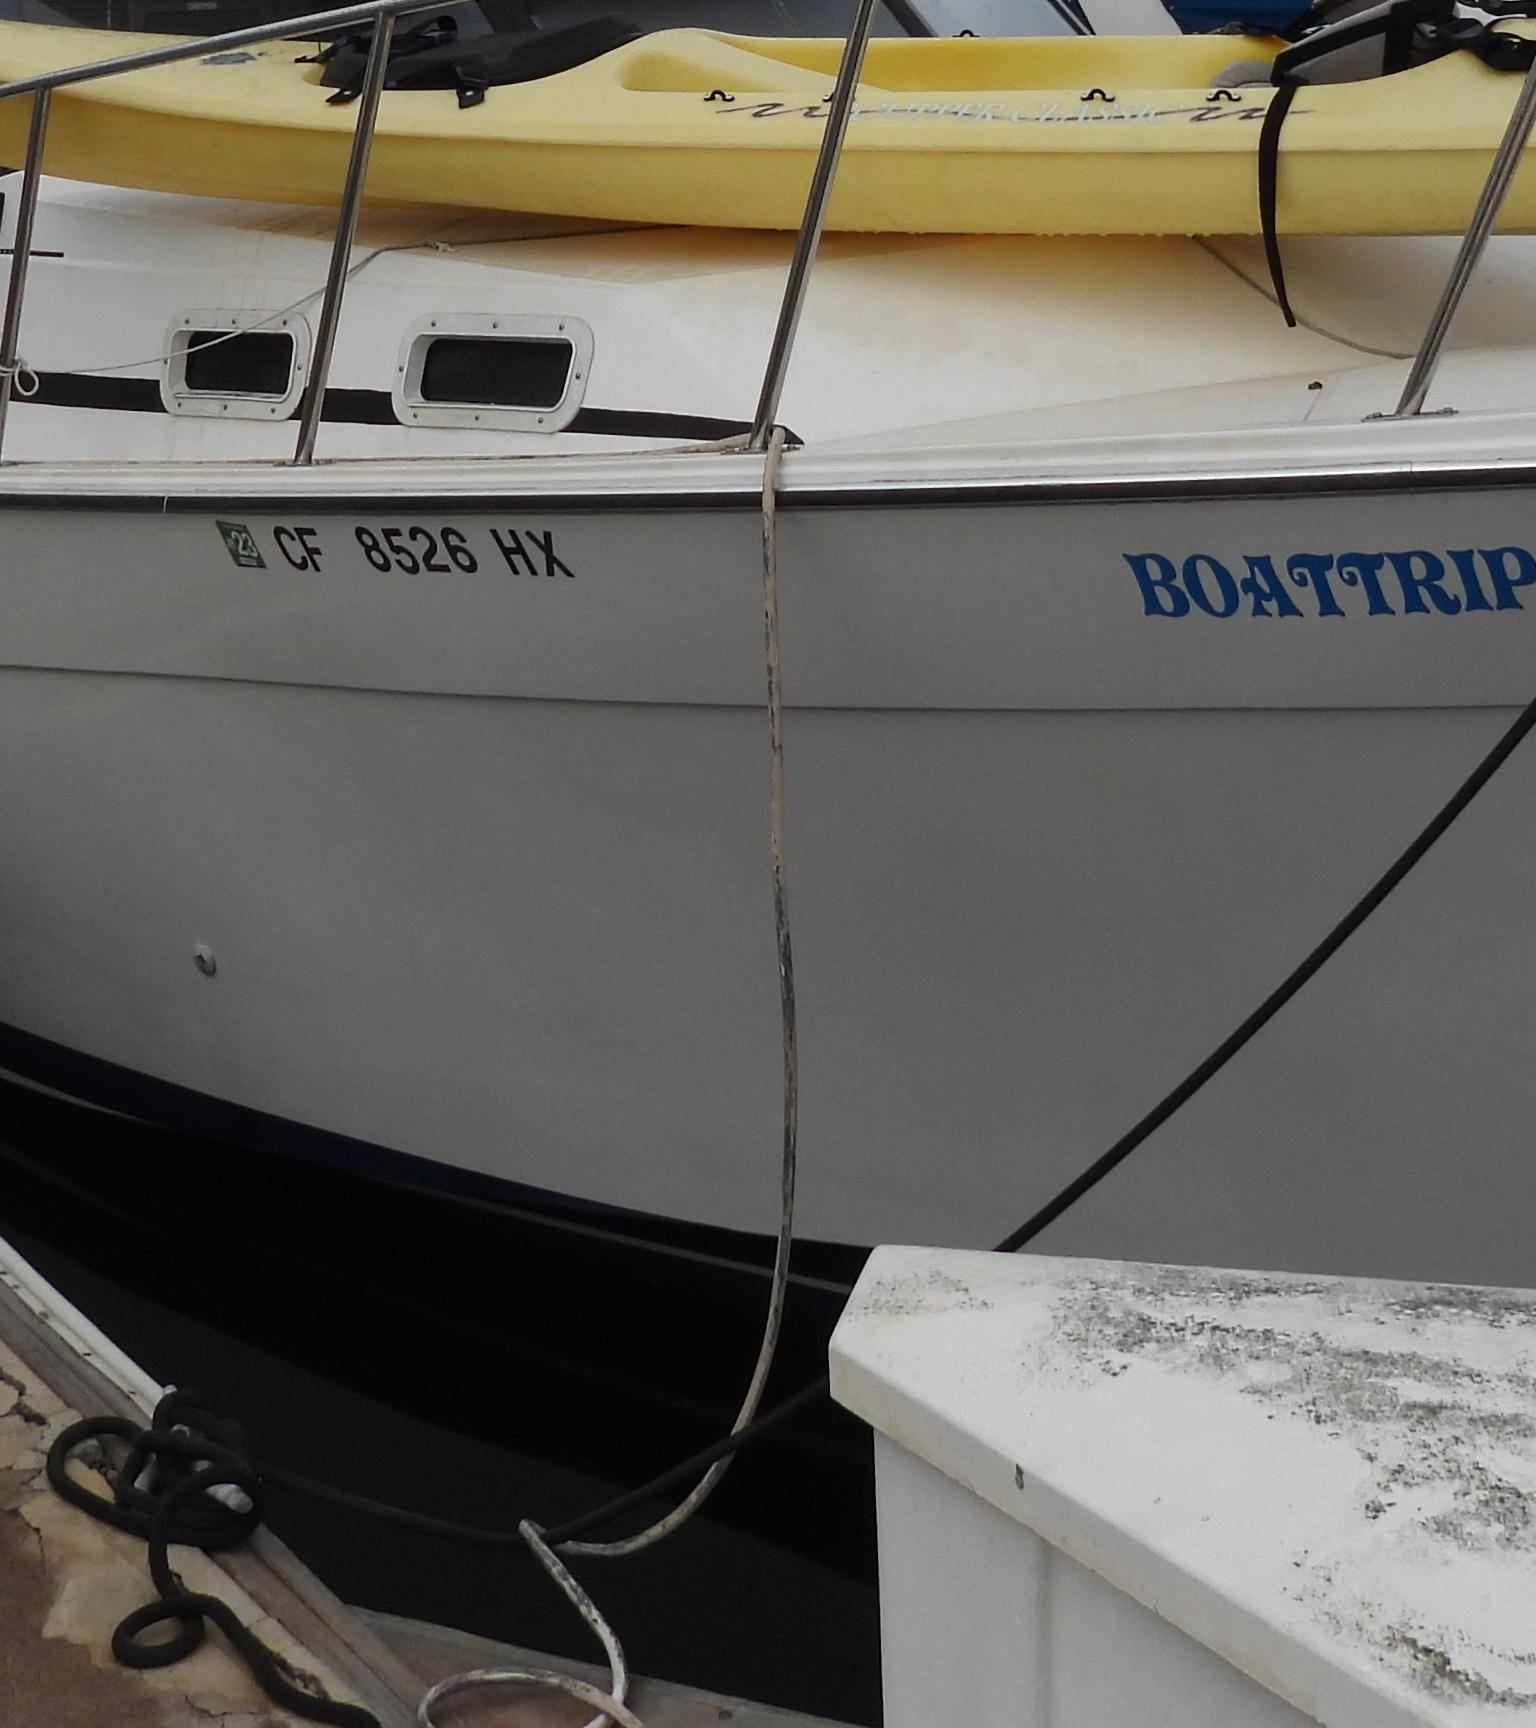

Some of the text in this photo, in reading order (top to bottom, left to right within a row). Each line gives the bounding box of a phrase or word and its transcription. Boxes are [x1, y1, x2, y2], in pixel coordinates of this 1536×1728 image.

[272, 524, 576, 579] CF 8526 HX
